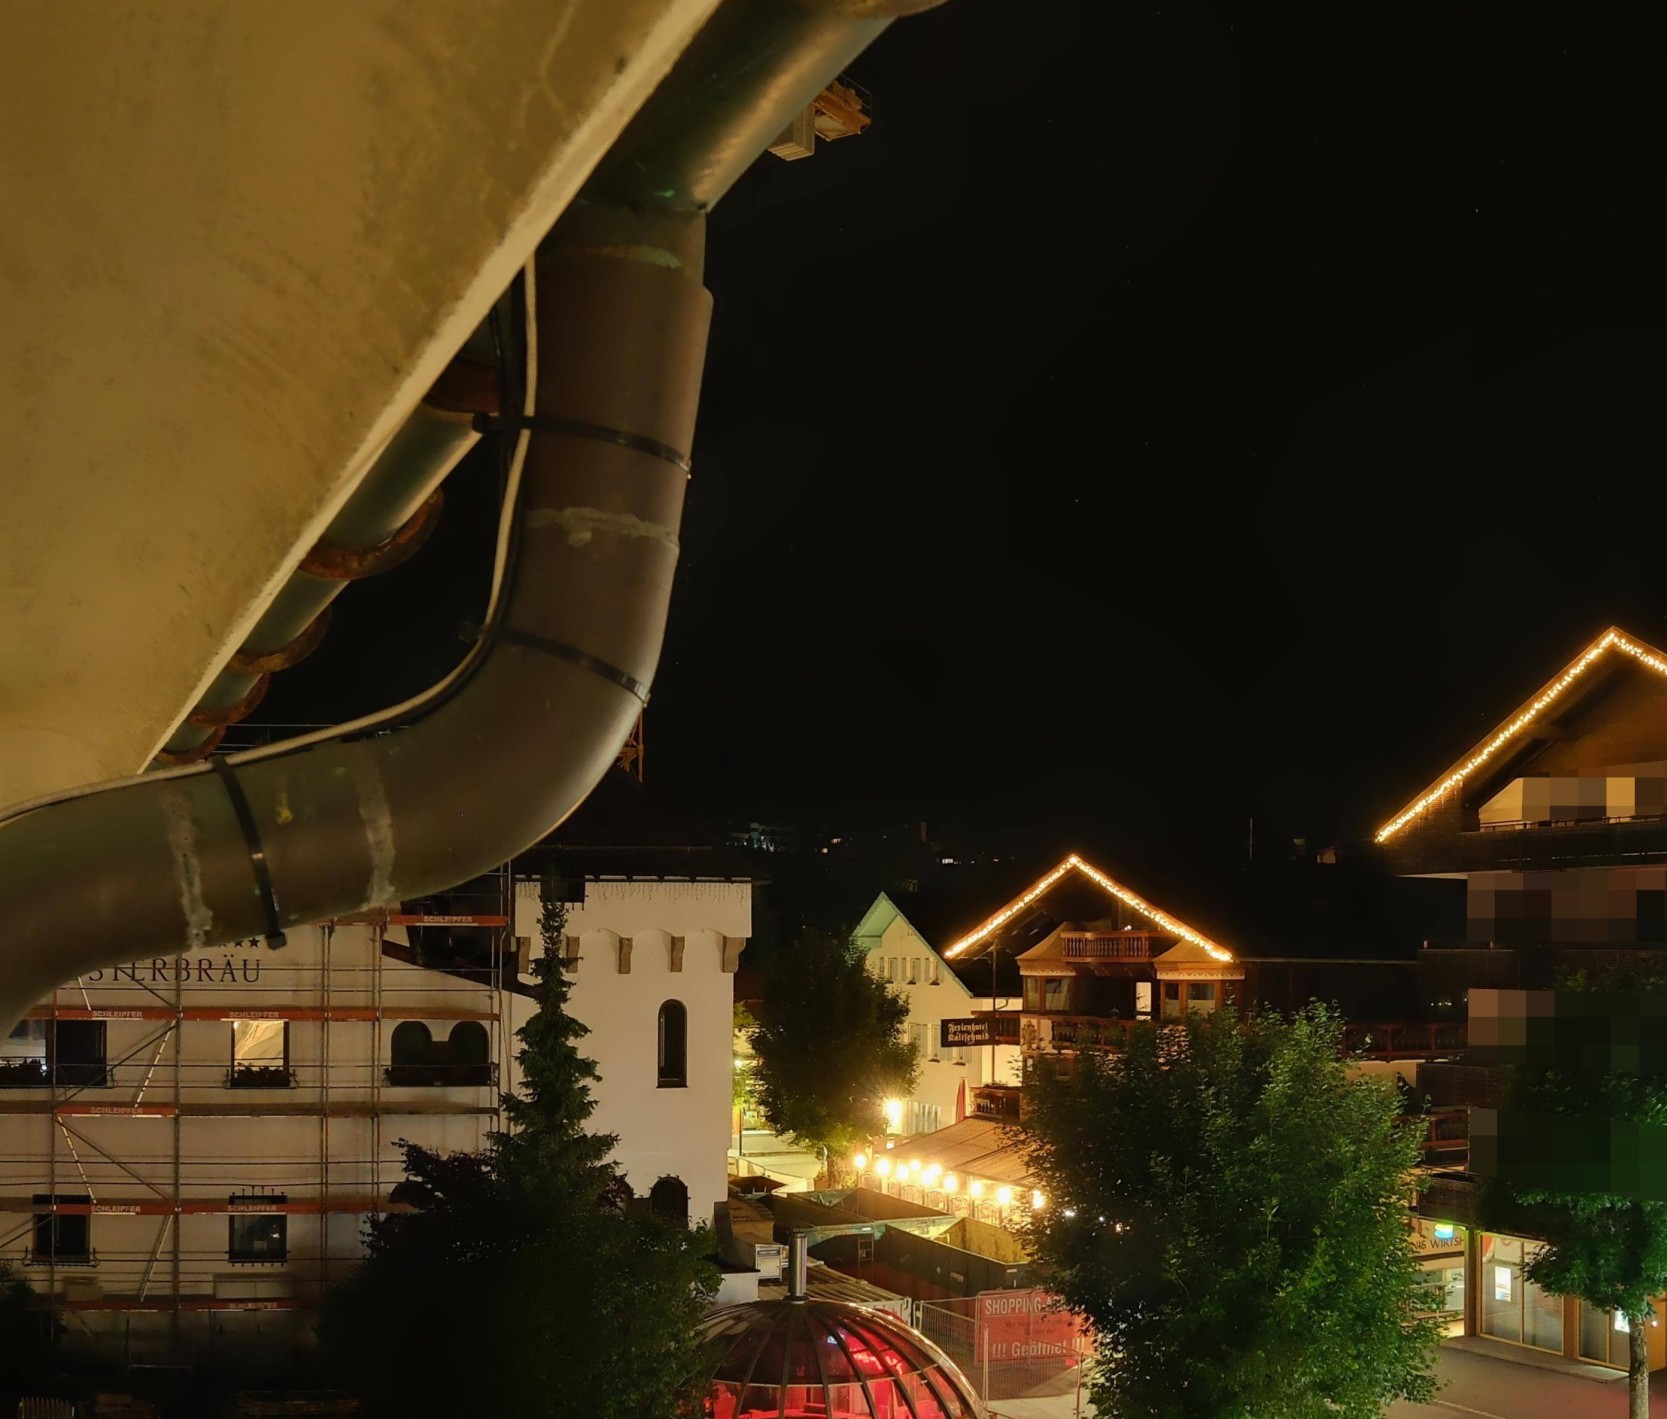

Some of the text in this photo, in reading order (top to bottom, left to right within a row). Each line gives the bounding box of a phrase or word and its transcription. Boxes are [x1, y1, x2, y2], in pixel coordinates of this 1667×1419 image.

[423, 915, 473, 923] SCHLEIPFER
[92, 1010, 143, 1018] SCHLEIPFER
[229, 1010, 280, 1018] SCHLEIPFER
[90, 1205, 142, 1213] SCHLEIPFER
[1011, 1338, 1068, 1358] Geöffnet
